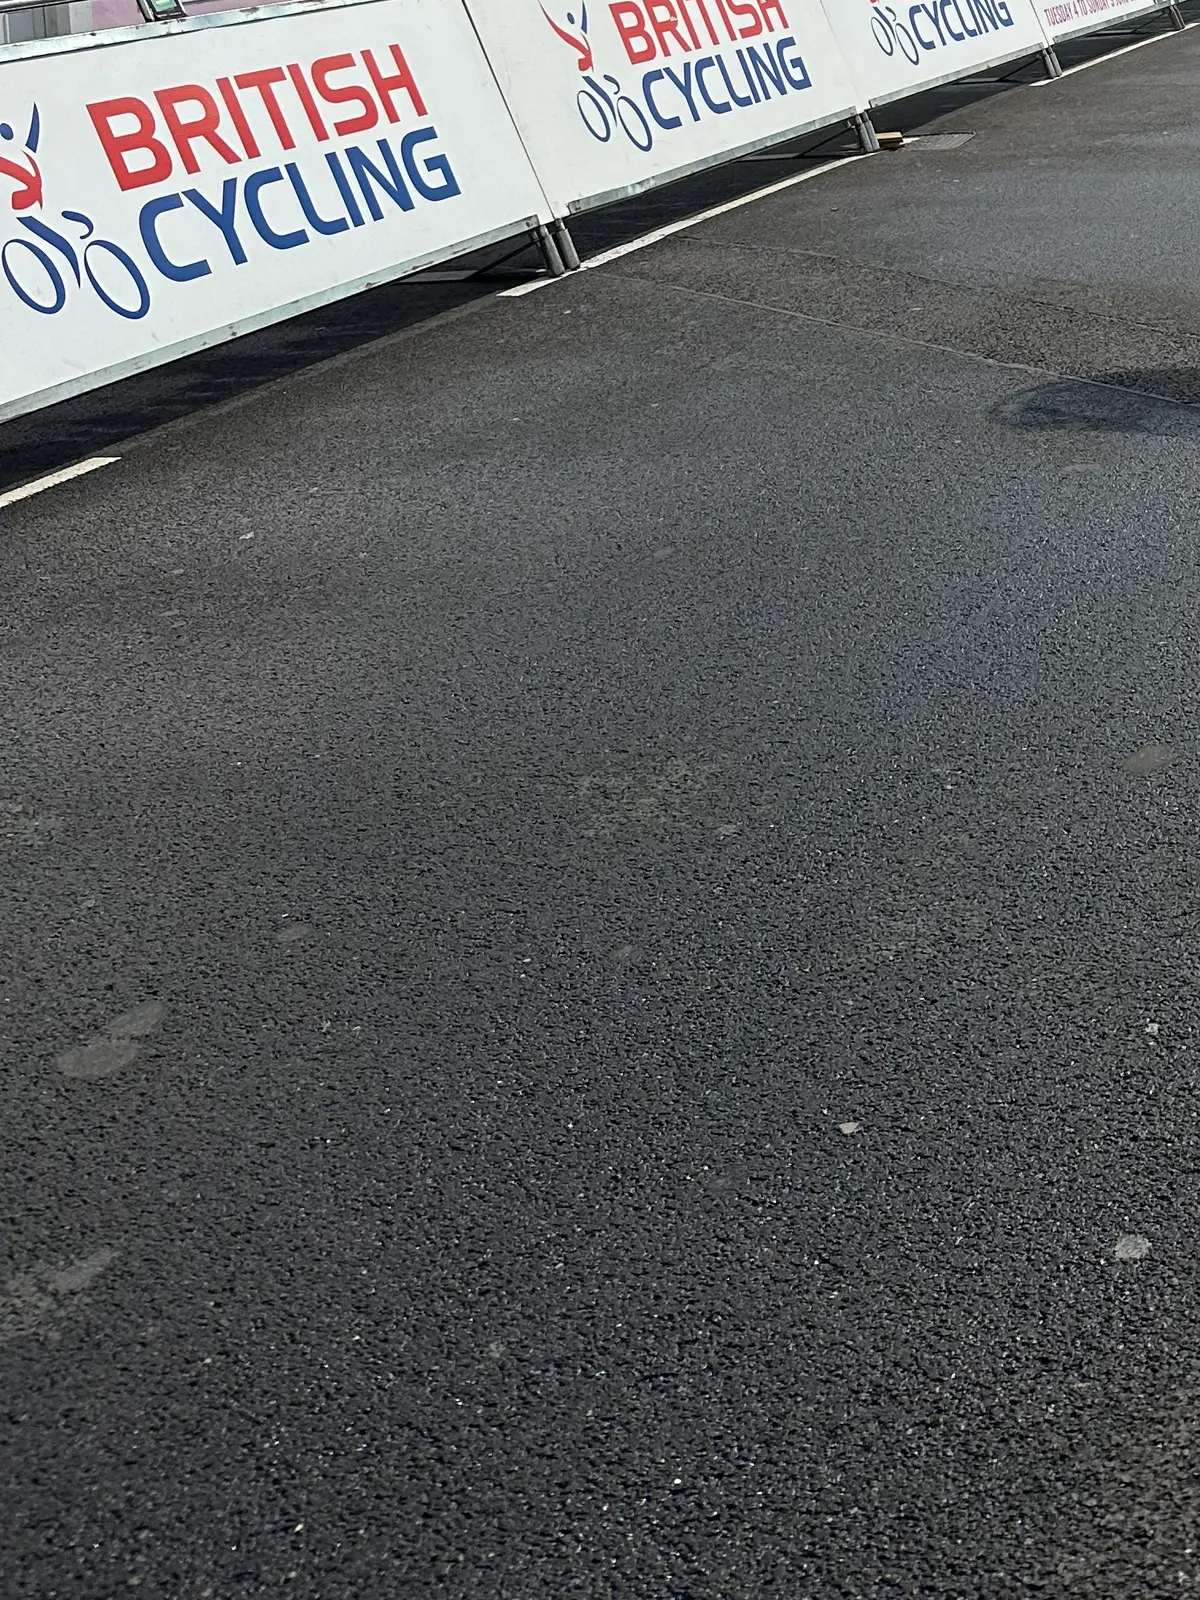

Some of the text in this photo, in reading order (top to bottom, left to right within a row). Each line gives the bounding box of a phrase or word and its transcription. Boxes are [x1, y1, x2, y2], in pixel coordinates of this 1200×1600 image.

[1043, 2, 1075, 27] TUESDAY
[85, 43, 429, 192] BRITISH
[642, 36, 813, 130] CYCLING
[138, 125, 462, 283] CYCLING
